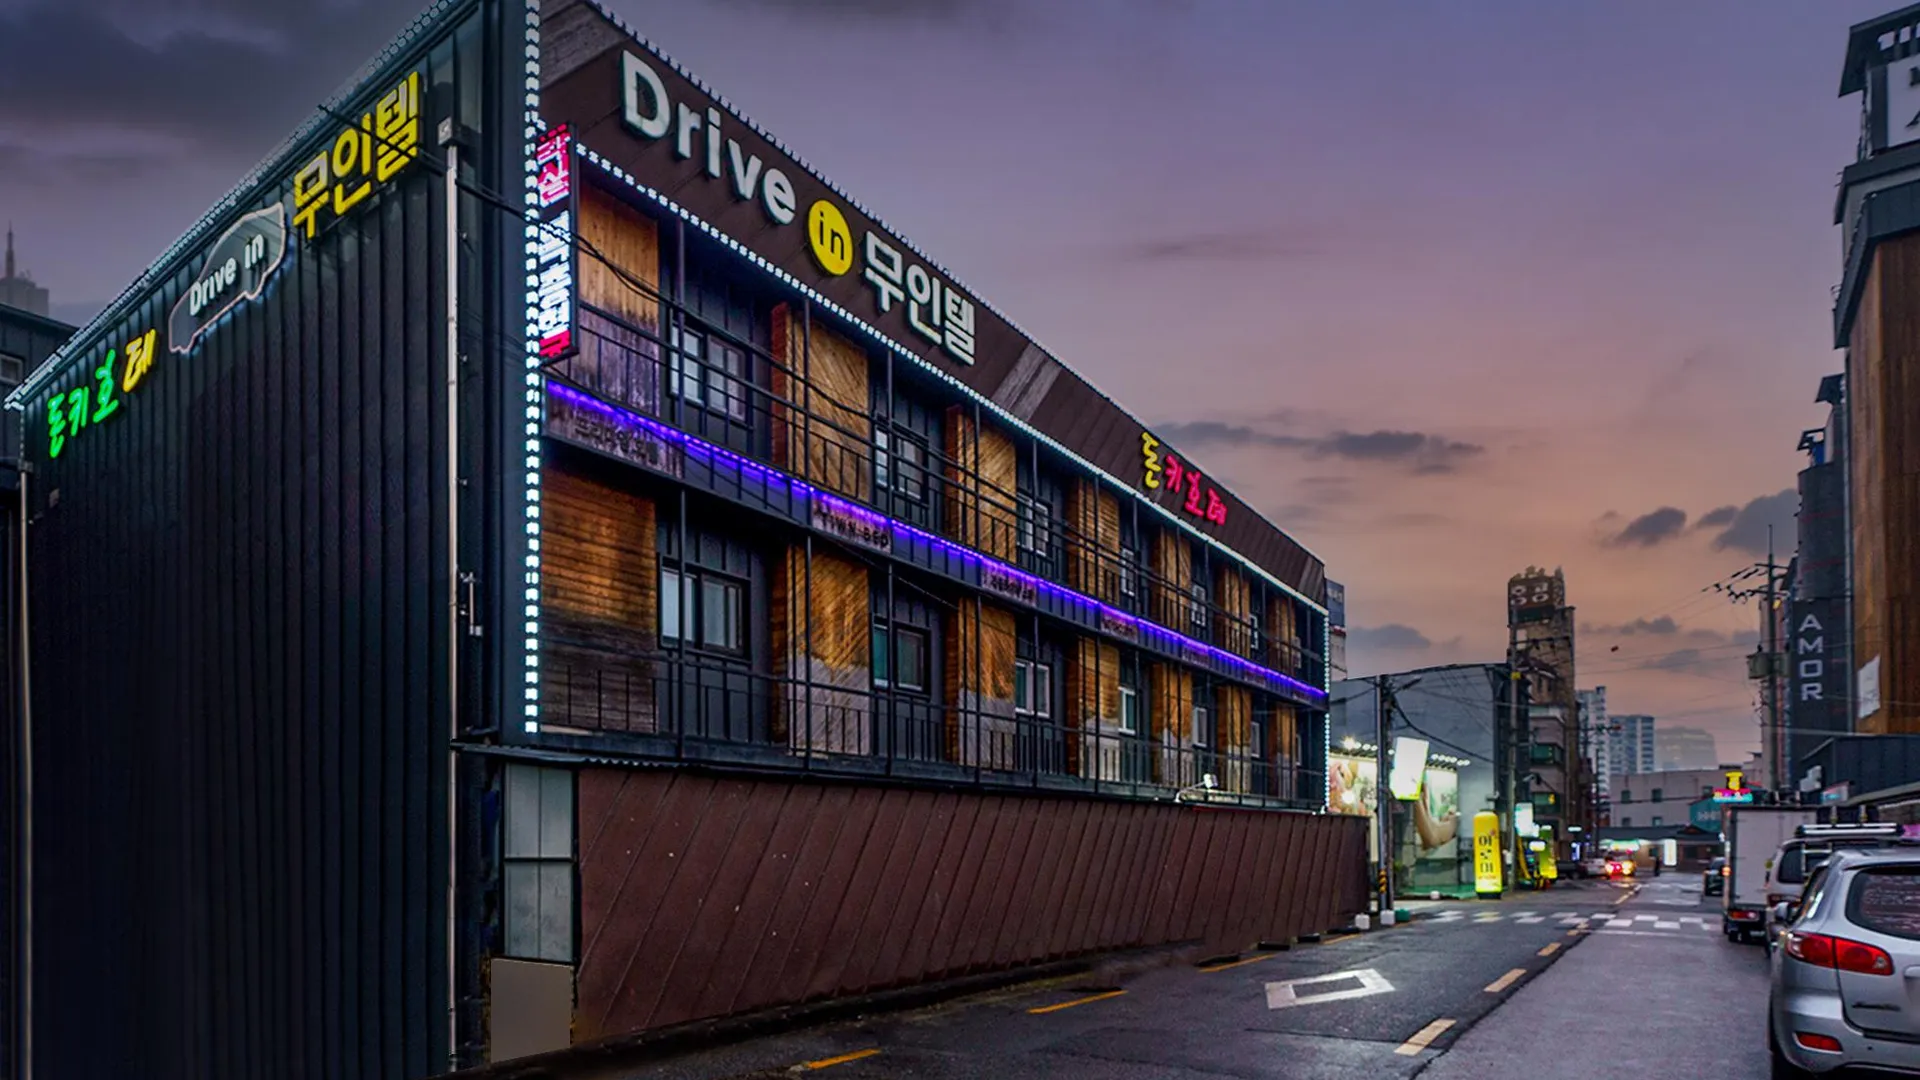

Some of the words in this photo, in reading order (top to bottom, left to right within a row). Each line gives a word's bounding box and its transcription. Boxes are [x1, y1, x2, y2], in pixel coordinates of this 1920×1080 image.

[292, 71, 419, 241] 무인텔
[621, 49, 797, 226] Drive
[819, 209, 845, 262] in
[864, 229, 976, 367] 무인텔
[189, 256, 238, 317] Drive
[244, 233, 265, 270] in
[1798, 613, 1824, 701] AMOR
